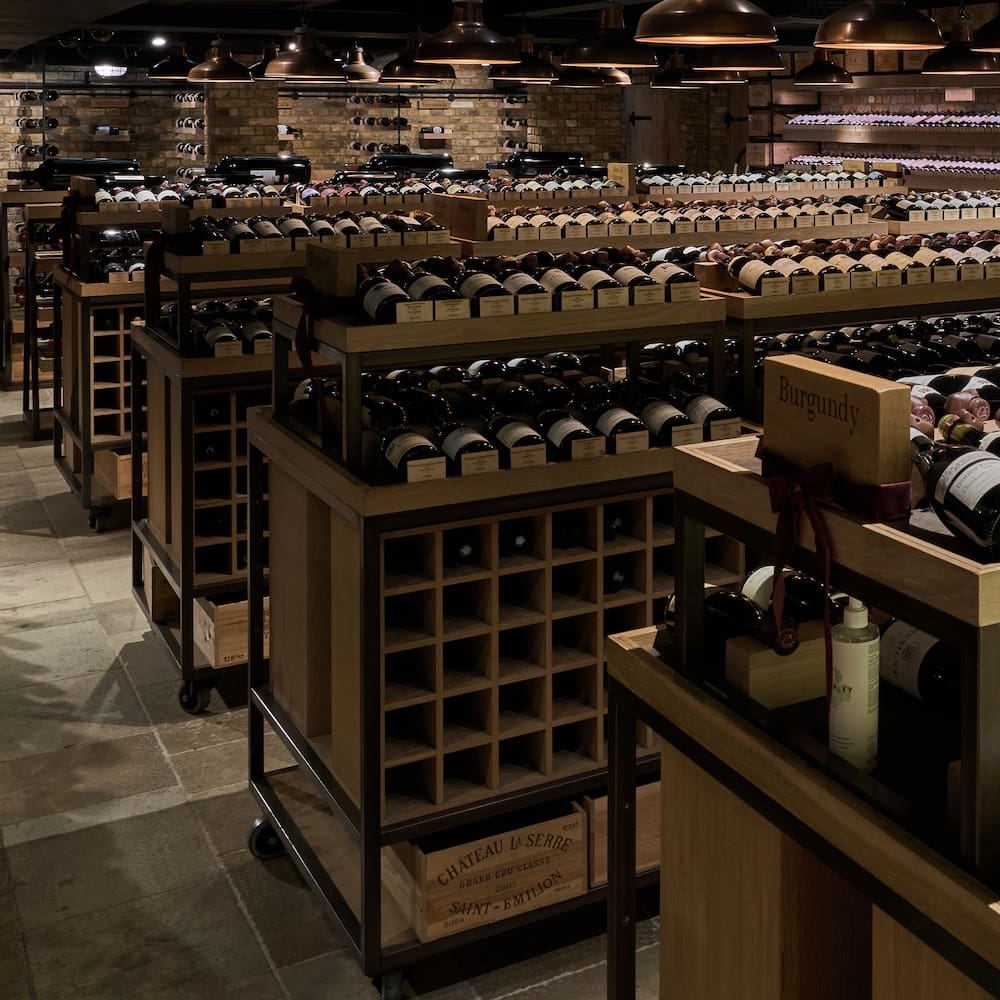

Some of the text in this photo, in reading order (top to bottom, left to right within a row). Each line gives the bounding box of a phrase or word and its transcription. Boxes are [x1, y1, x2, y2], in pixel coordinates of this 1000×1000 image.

[779, 375, 861, 436] Burgundy
[437, 839, 503, 886] CHATEAU
[525, 833, 573, 852] SERRE
[459, 855, 551, 889] GRAND CRU CLASSE
